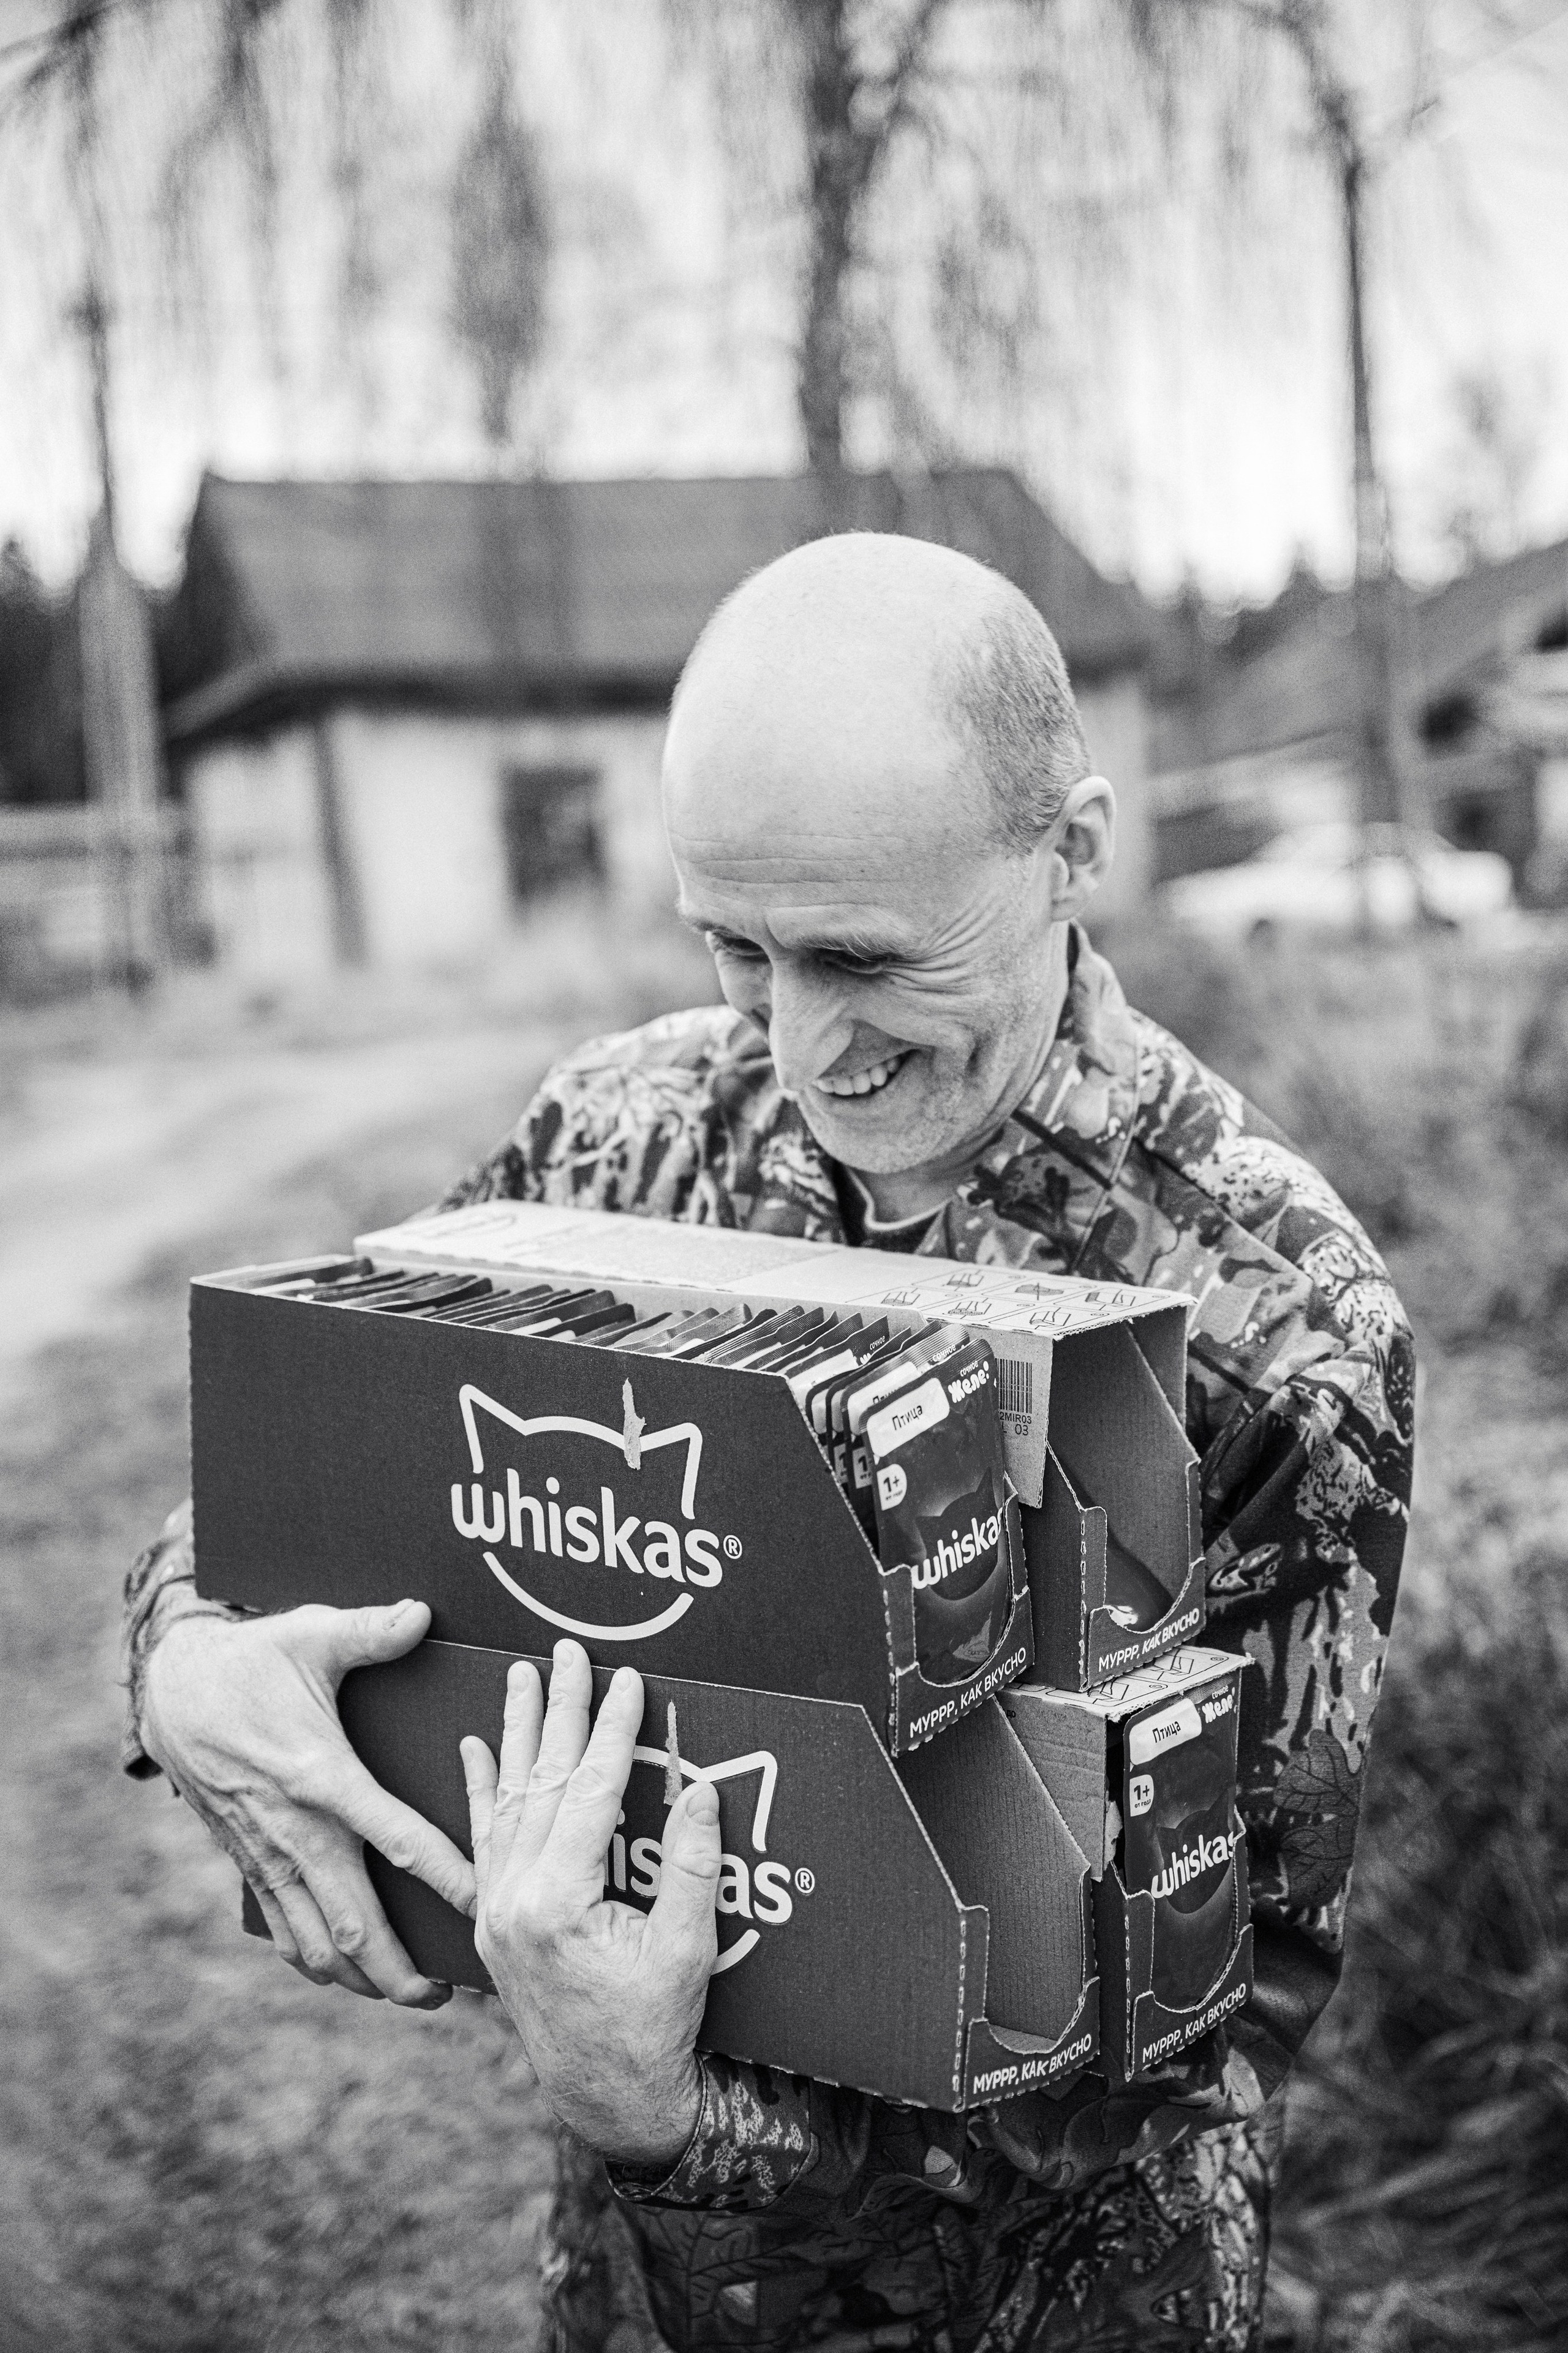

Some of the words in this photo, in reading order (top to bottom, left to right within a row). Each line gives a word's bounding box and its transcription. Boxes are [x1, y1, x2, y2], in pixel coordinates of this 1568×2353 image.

[870, 1335, 885, 1350] сочное
[960, 1360, 979, 1377] сочное
[948, 1361, 990, 1403] Желе!
[892, 1405, 923, 1430] Птица
[883, 1476, 900, 1492] 1+
[1099, 1645, 1140, 1672] МУРРР,
[1142, 1631, 1161, 1655] КАК
[1162, 1608, 1200, 1644] ВКУСНО
[910, 1701, 958, 1738] МУРРР,
[960, 1681, 982, 1709] КАК
[984, 1647, 1026, 1692] ВКУСНО
[1152, 1721, 1182, 1743] Птица
[1134, 1785, 1150, 1800] 1+
[1142, 2030, 1183, 2063] МУРРР,
[1185, 2014, 1206, 2039] КАК
[1207, 1983, 1246, 2024] ВКУСНО
[973, 2065, 1019, 2094] МУРРР,
[1021, 2060, 1049, 2080] КАК
[1049, 2033, 1092, 2074] ВКУСНО
